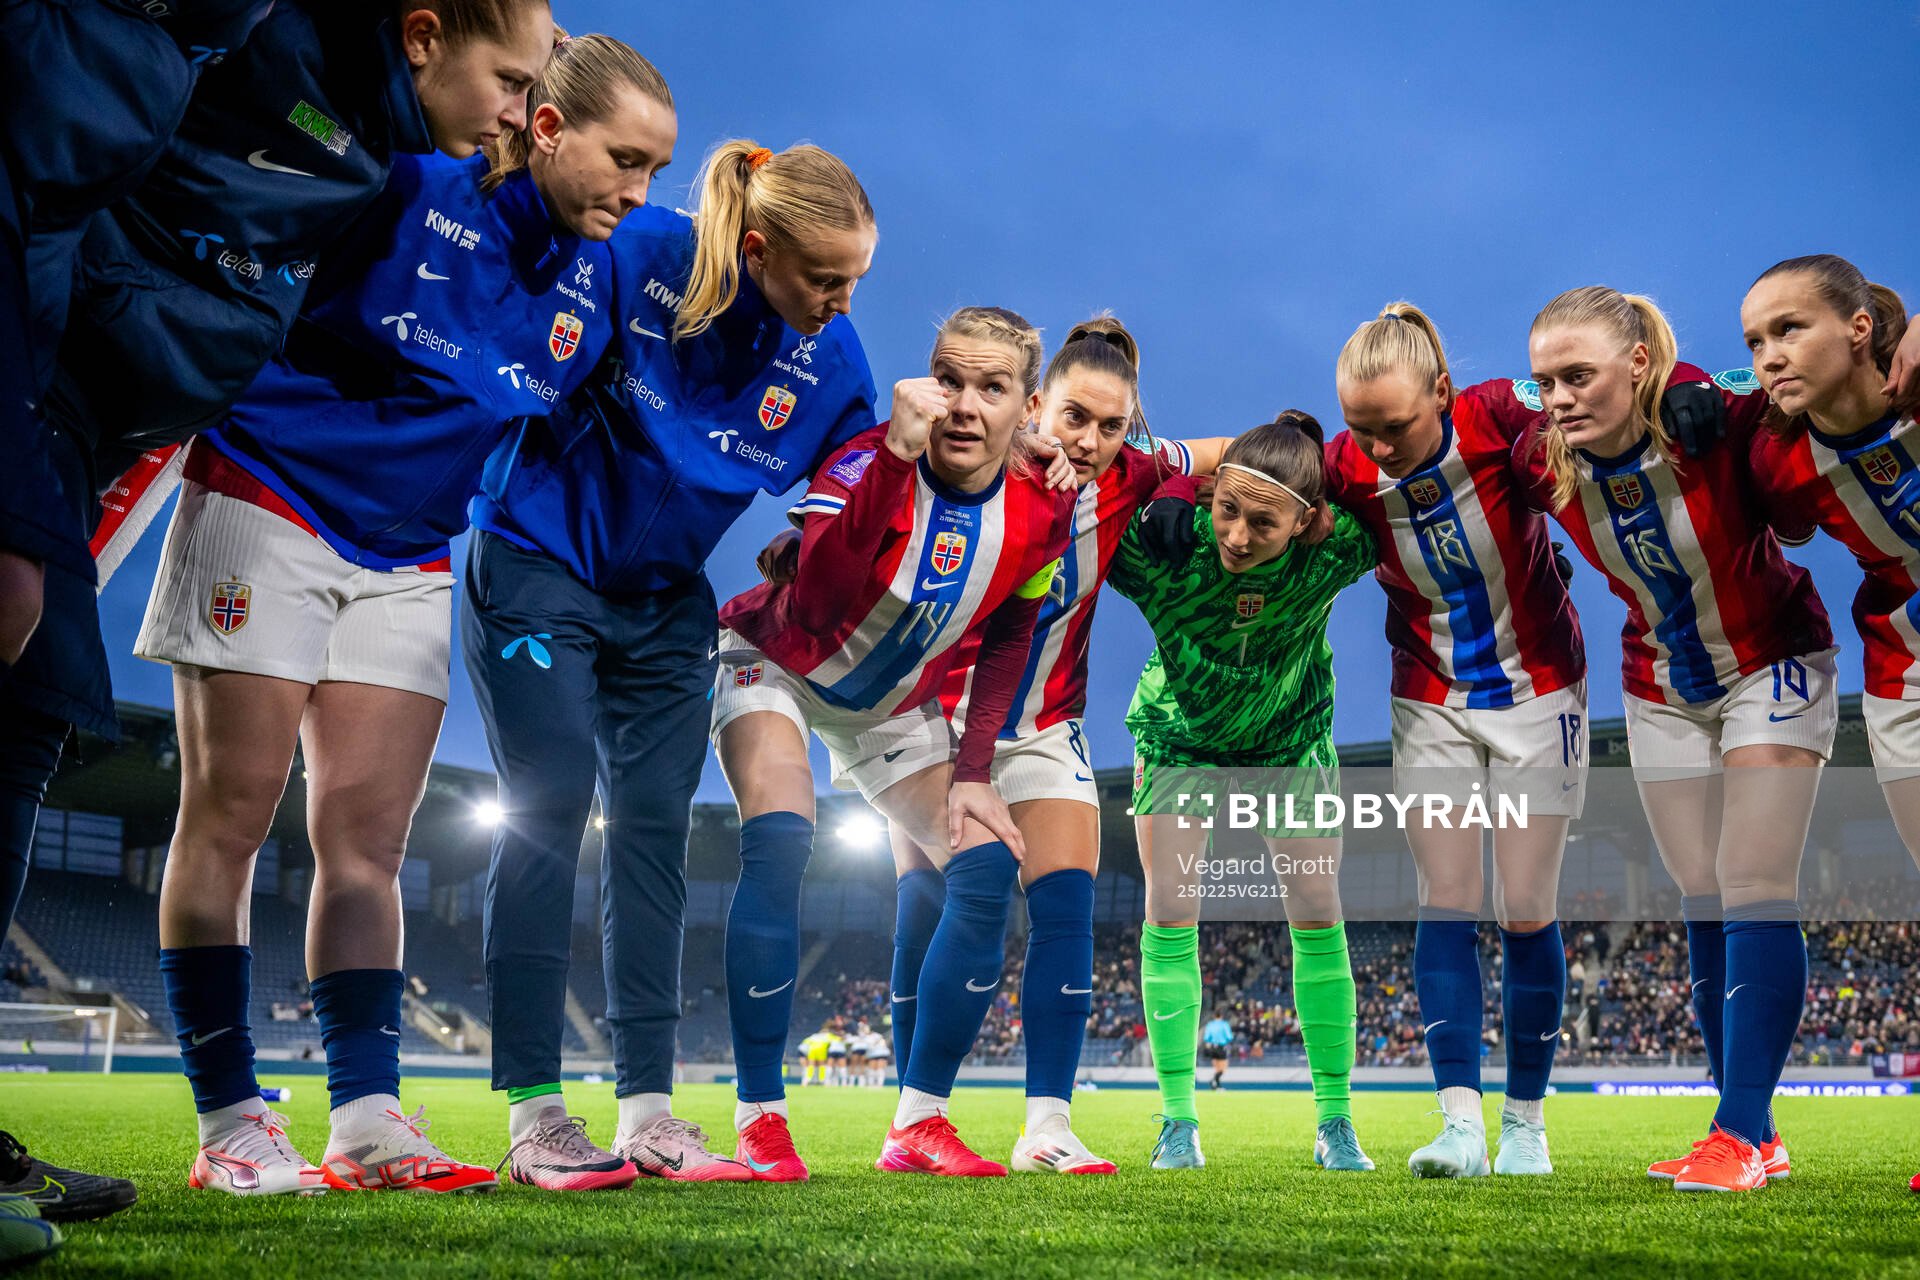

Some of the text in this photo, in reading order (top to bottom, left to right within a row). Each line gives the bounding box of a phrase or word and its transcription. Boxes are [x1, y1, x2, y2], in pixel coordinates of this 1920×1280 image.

[288, 100, 339, 146] KIWI
[333, 129, 352, 147] mini
[425, 208, 463, 243] KIWI
[463, 229, 481, 243] mini
[458, 237, 476, 251] pris
[556, 281, 577, 300] Norsk
[643, 277, 685, 313] KIWI
[413, 323, 463, 360] telenor
[773, 358, 819, 386] Norsk Tipping
[623, 371, 667, 412] telenor
[735, 440, 788, 472] telenor
[1422, 519, 1472, 574] 18
[1623, 528, 1680, 578] 16
[897, 601, 952, 648] 14
[1557, 713, 1581, 768] 18
